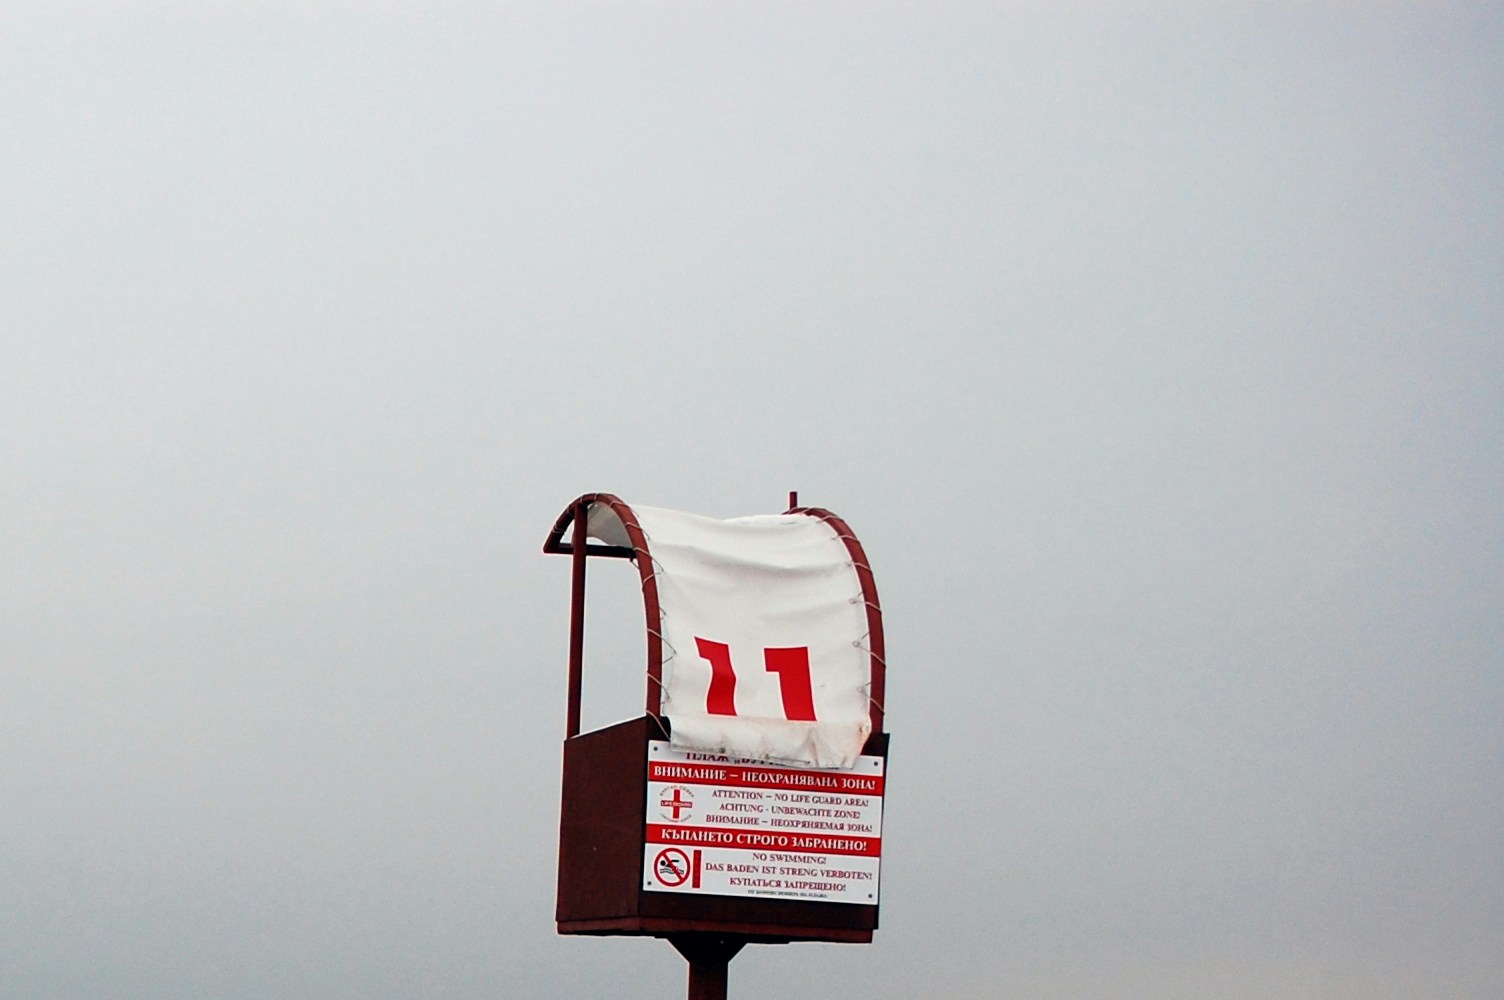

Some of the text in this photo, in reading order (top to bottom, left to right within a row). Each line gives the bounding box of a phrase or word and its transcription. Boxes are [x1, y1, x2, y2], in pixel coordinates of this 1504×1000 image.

[694, 636, 817, 721] 11
[654, 766, 727, 780] ВНИМАНИЕ
[742, 771, 838, 788] НЕОХРАНЯВАНА
[841, 778, 876, 790] ЗОНА!
[712, 790, 763, 800] ATTENTION
[774, 793, 788, 801] NO
[791, 794, 810, 803] LIFE
[812, 796, 842, 806] GUARD
[844, 798, 869, 807] AREA!
[720, 803, 763, 813] ACHTUNG
[771, 806, 832, 818] UNBEWACHTE
[834, 810, 860, 819] ZONE!
[706, 815, 760, 825] ВНИМАНИЕ
[847, 823, 873, 832] ЗОНА!
[661, 828, 867, 851] КЪПАНЕТО СТРОГО ЗАБРАНЕНО!
[752, 853, 827, 864] NO SWIMMING!
[705, 863, 873, 880] DAS BADEN IST STRENG VERBOTEN!
[729, 877, 846, 892] КУПАТЬСЯ ЗАПРЕЩЕНО!
